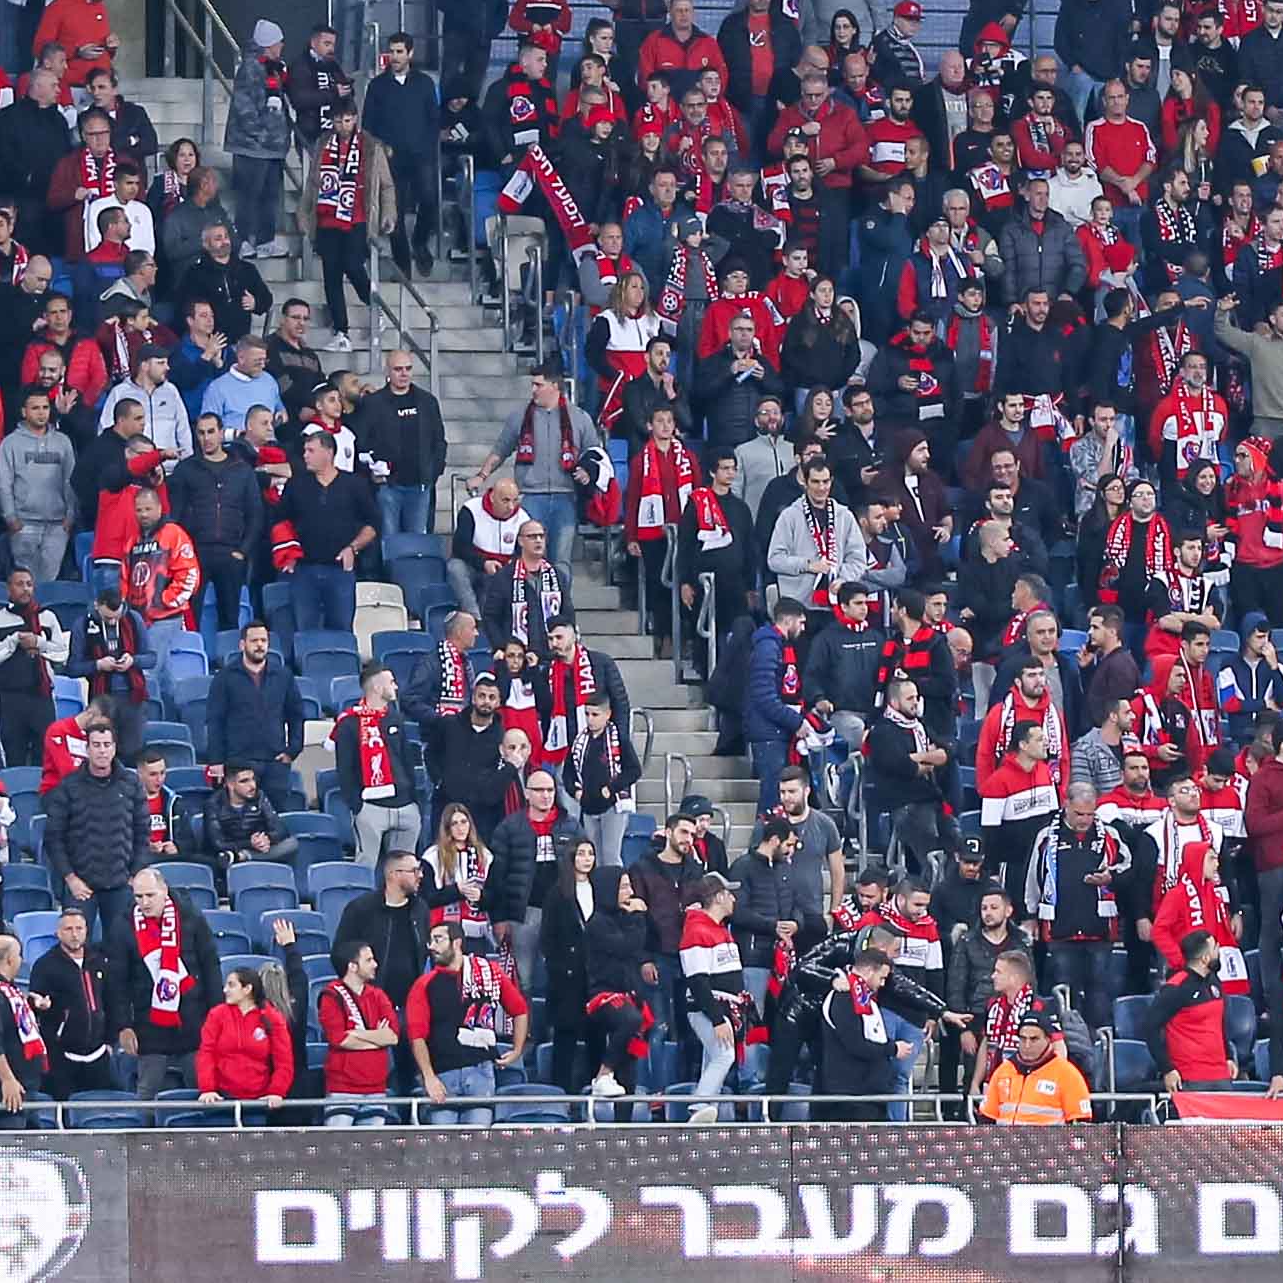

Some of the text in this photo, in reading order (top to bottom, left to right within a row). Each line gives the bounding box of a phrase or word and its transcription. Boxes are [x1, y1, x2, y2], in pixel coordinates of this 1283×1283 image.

[550, 174, 586, 228] הפועל
[254, 1169, 614, 1280] לקווים
[640, 1183, 974, 1260] מעבר
[1009, 1182, 1159, 1255] גם
